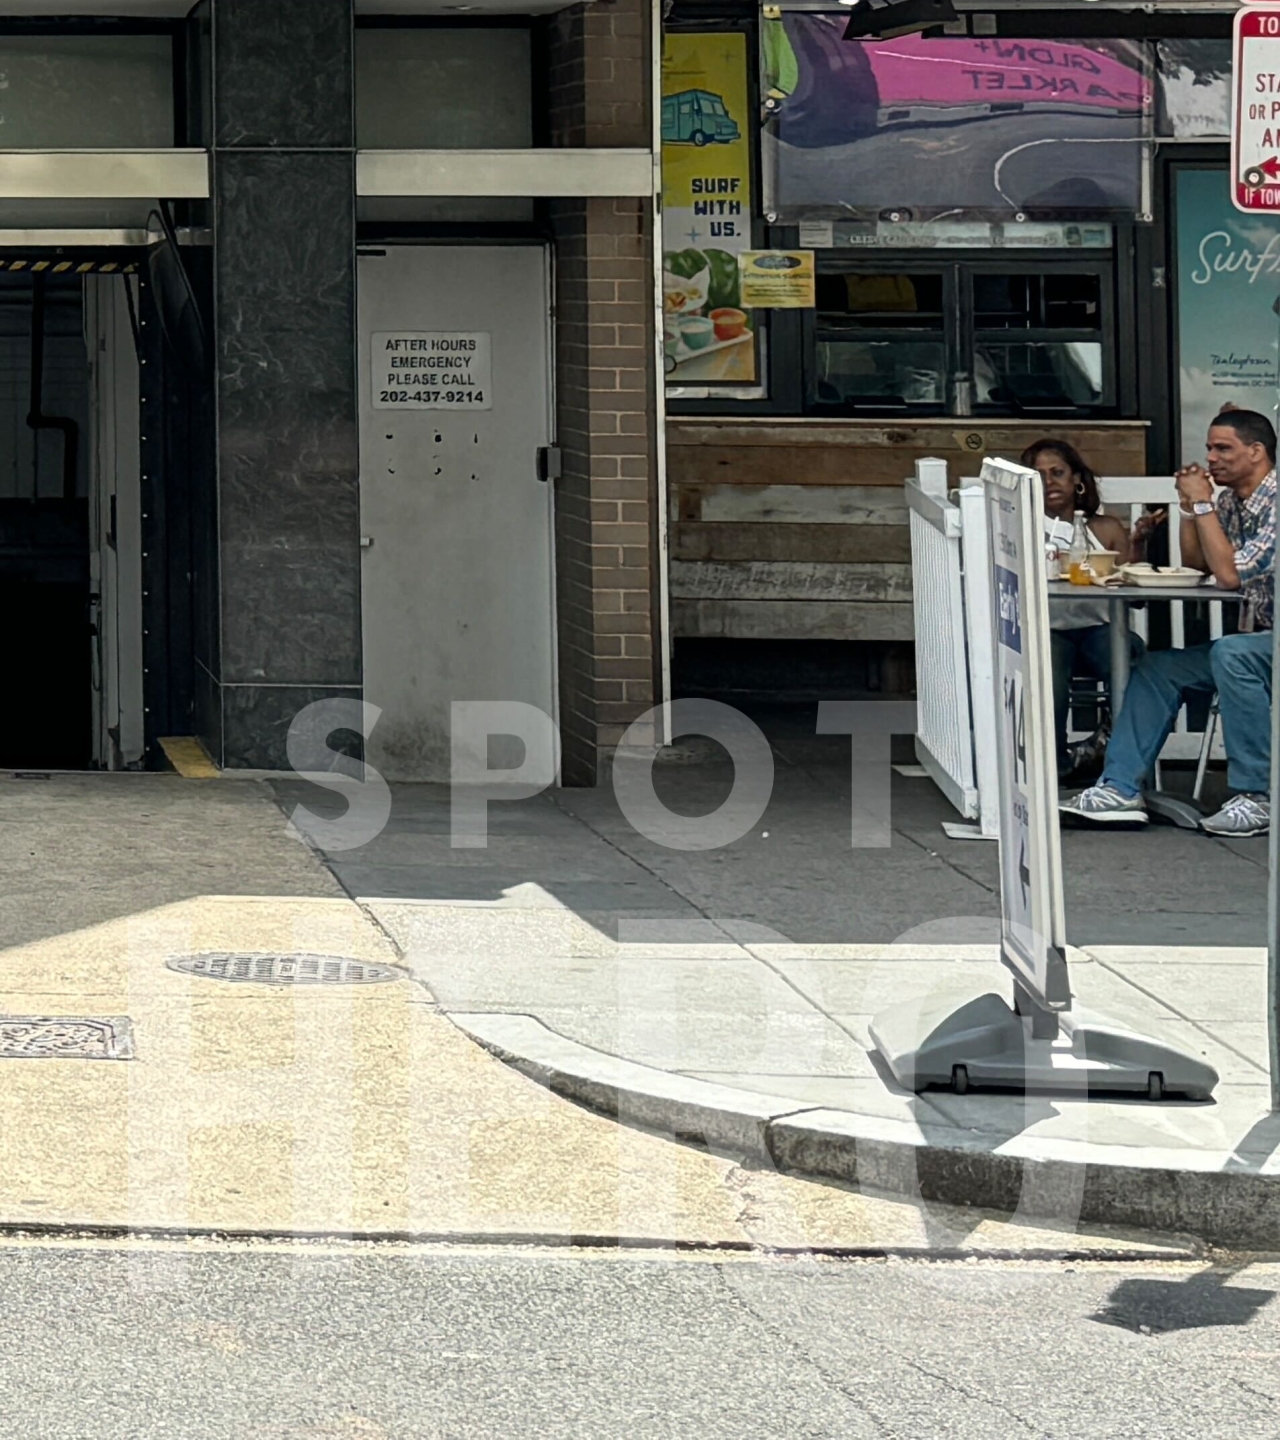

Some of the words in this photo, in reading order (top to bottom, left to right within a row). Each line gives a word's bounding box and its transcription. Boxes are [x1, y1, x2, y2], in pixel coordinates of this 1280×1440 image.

[1249, 104, 1266, 120] OR
[692, 178, 741, 194] SURF
[694, 200, 741, 215] WITH
[710, 221, 742, 237] US.
[385, 339, 428, 351] AFTER
[431, 339, 477, 351] HOURS
[391, 356, 472, 368] EMERGENCY
[387, 373, 438, 386] PLEASE
[441, 373, 475, 386] CALL
[380, 390, 484, 403] 202-437-9214
